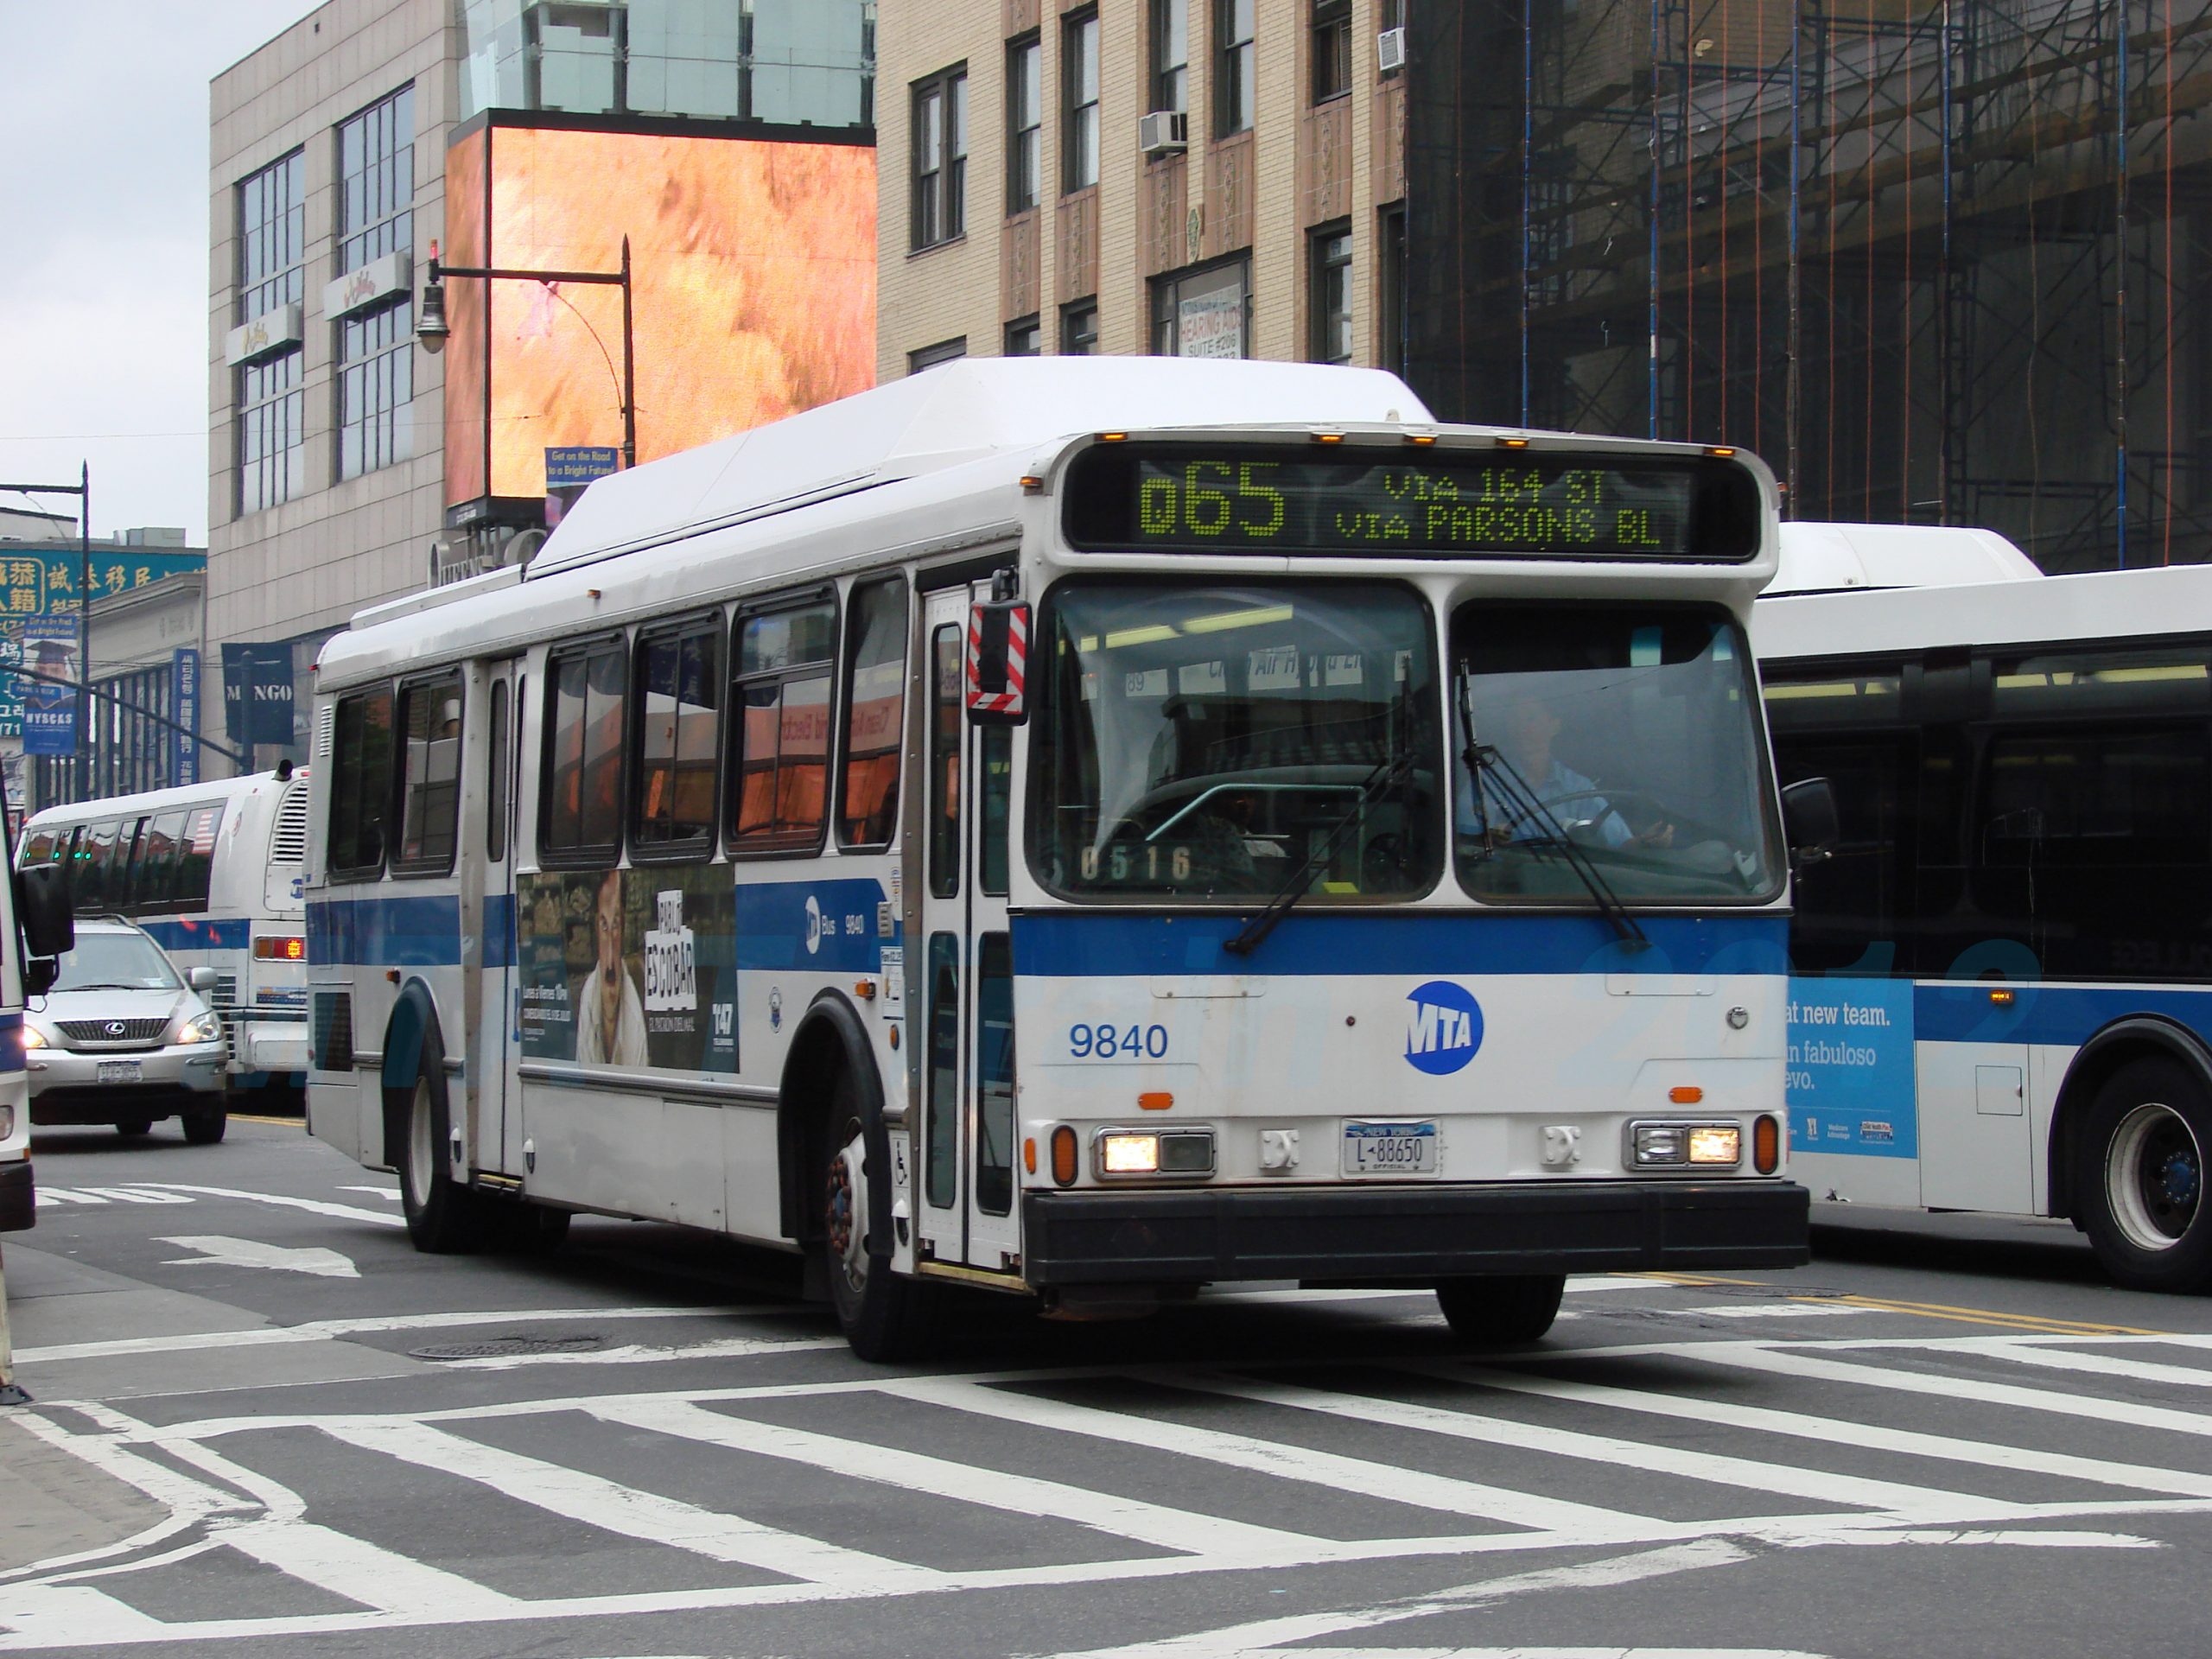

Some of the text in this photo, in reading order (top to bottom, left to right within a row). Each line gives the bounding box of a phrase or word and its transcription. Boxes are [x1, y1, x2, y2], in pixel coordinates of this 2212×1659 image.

[1180, 310, 1220, 343] HEARING
[1187, 338, 1213, 358] SUITE
[1384, 470, 1459, 503] VIA
[1480, 467, 1545, 503] 164
[1566, 469, 1607, 504] ST
[1335, 505, 1662, 546] VIA PARSONS BL
[226, 683, 293, 702] MNGO
[821, 914, 836, 935] Bus
[845, 913, 865, 935] 9840
[646, 941, 695, 999] ESCOBAR
[1802, 1005, 1839, 1026] new
[1842, 1001, 1891, 1027] team.
[1068, 1022, 1169, 1058] 9840
[1803, 1039, 1877, 1066] fabuloso
